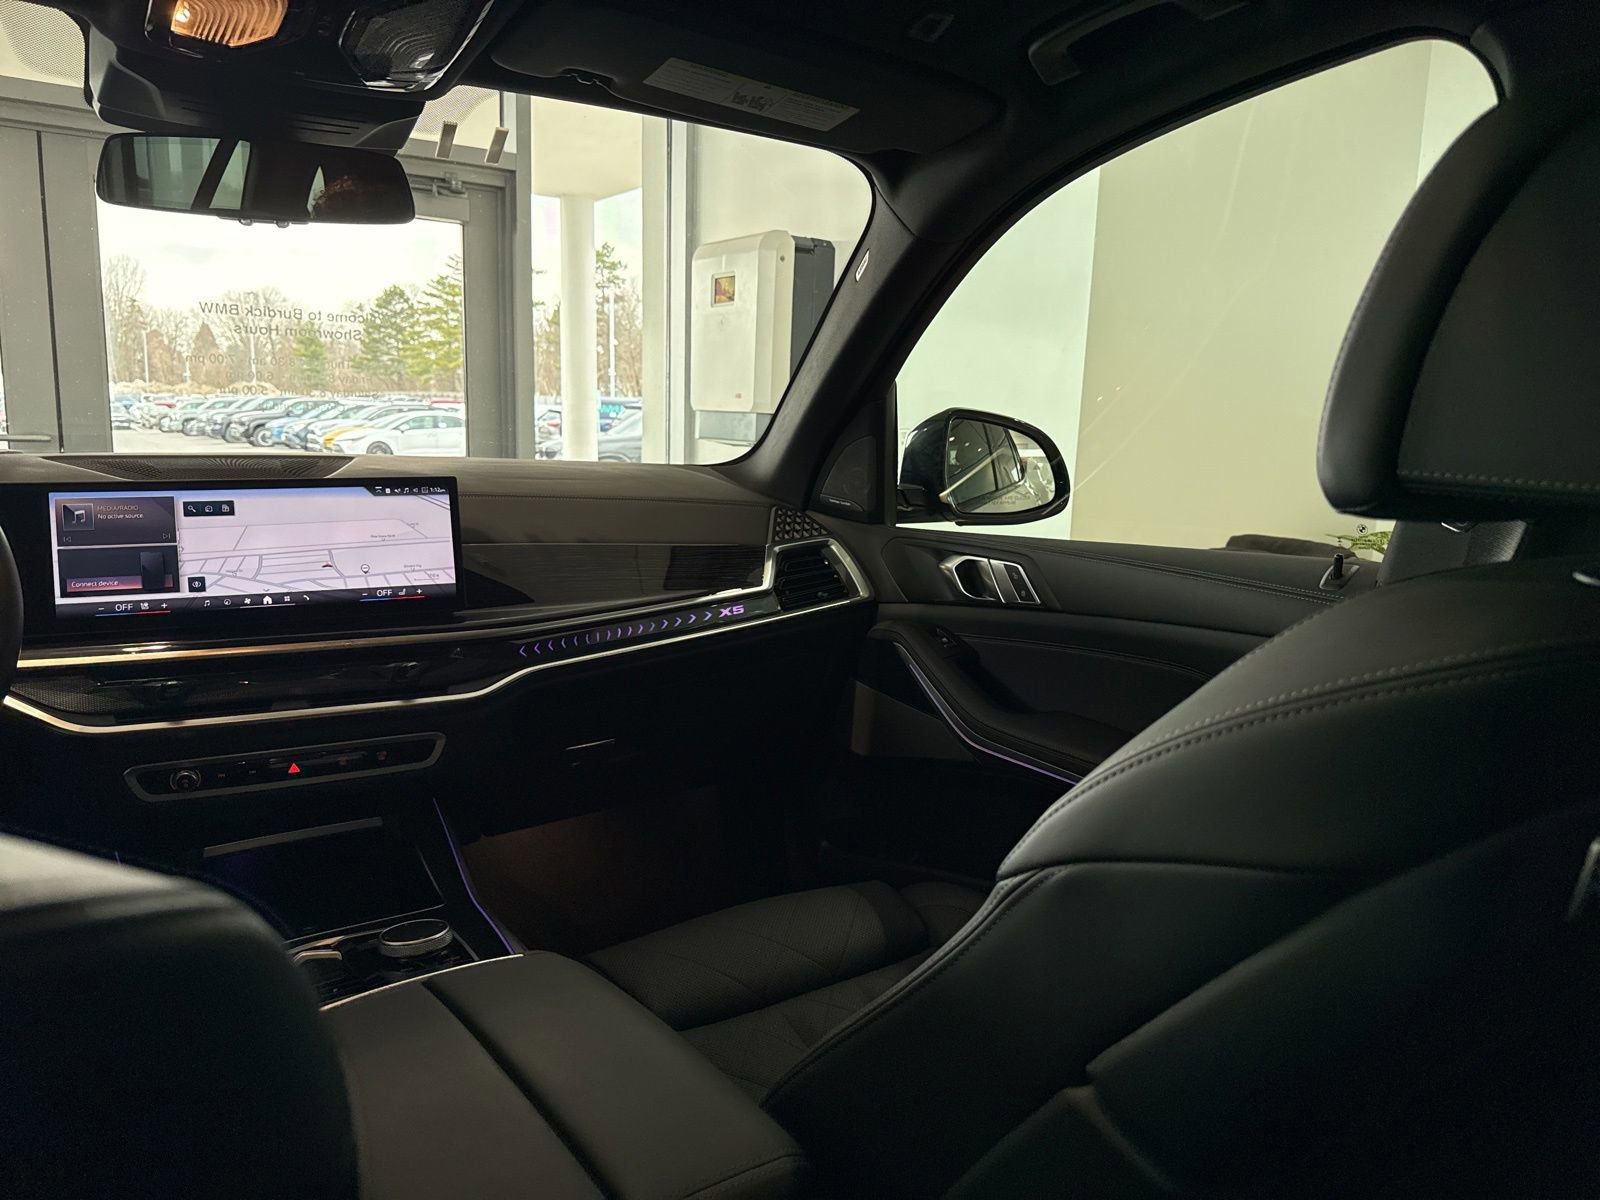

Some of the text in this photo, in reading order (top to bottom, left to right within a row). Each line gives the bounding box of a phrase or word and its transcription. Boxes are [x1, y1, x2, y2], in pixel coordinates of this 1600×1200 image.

[376, 589, 393, 597] OFF
[115, 603, 134, 612] OFF
[719, 604, 745, 618] X5
